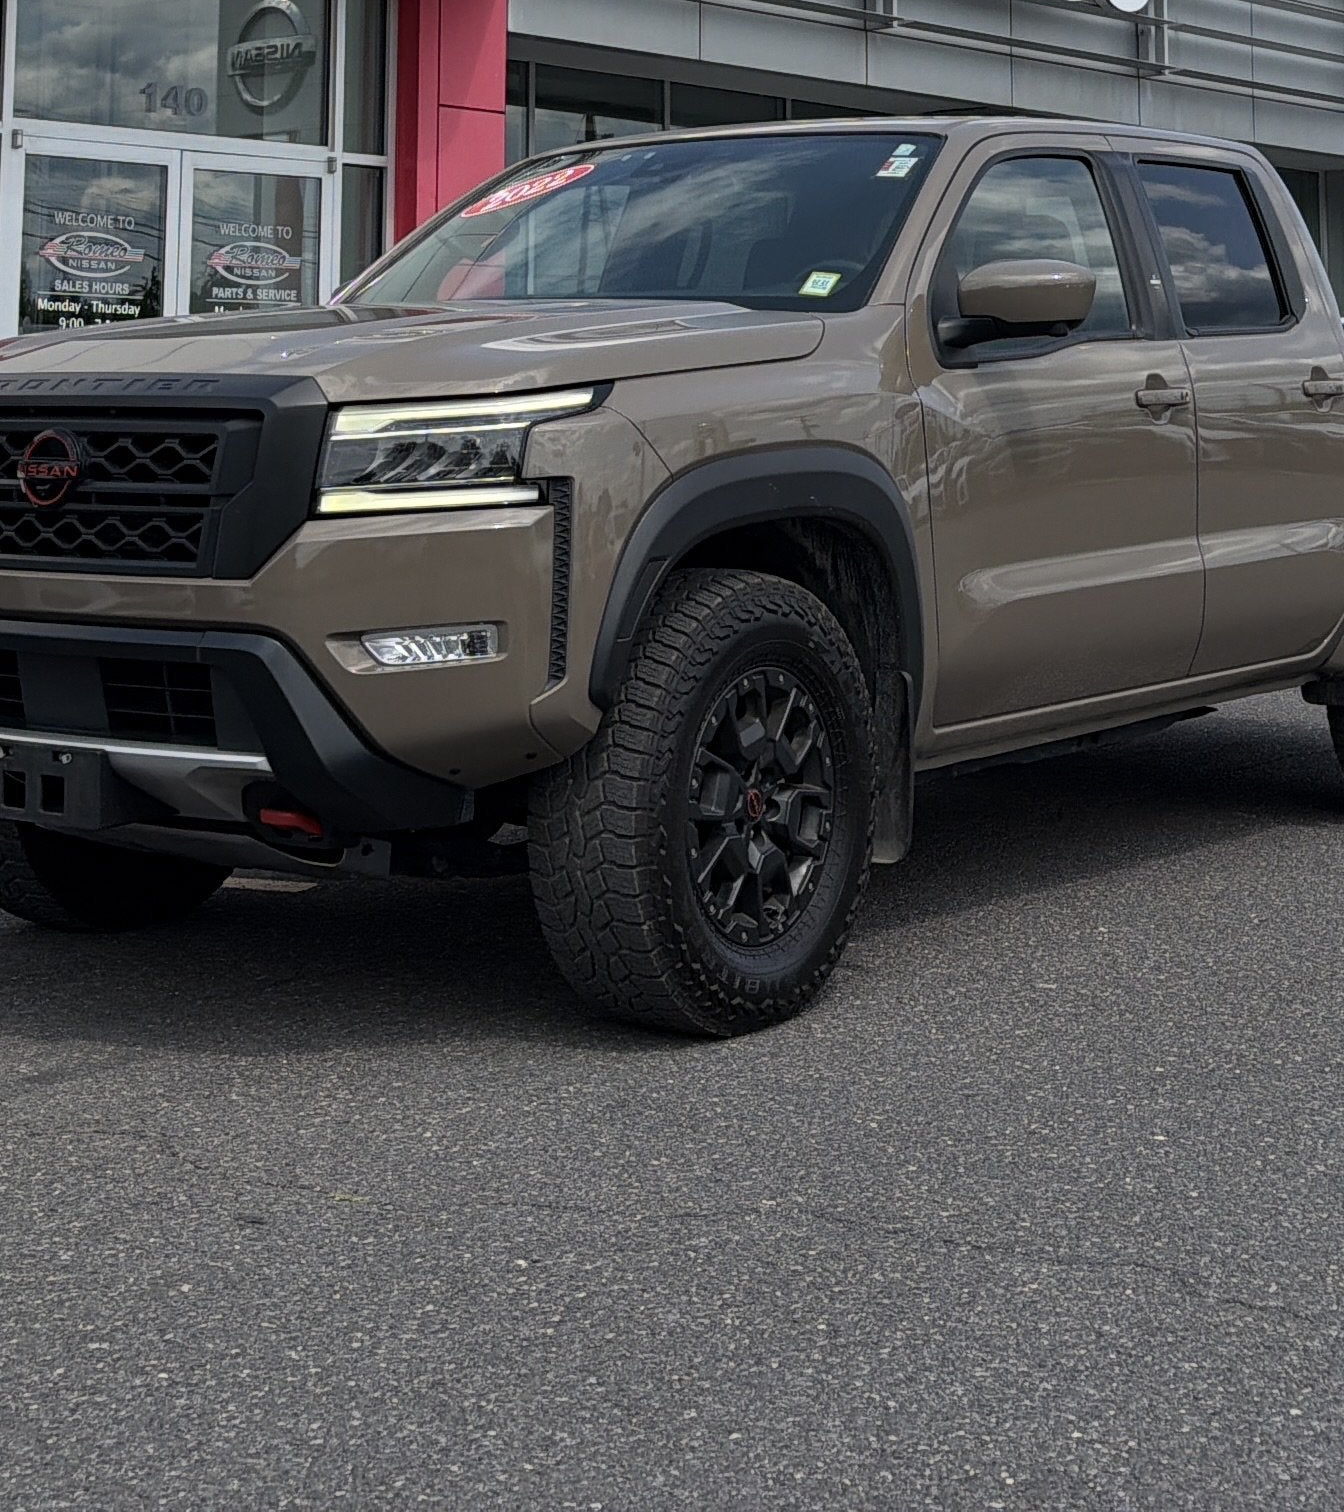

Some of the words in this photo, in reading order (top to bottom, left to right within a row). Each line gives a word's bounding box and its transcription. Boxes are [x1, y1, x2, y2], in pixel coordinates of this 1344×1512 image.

[139, 82, 209, 116] 140
[482, 168, 575, 211] 2022
[55, 211, 114, 228] WELCOME
[118, 216, 135, 229] TO
[219, 223, 274, 238] WELCOME
[276, 226, 292, 239] TO
[59, 235, 128, 258] Romeo
[225, 244, 287, 266] Romeo
[68, 258, 116, 270] NISSAN
[234, 267, 276, 277] NISSAN
[55, 279, 89, 293] SALES
[92, 281, 130, 295] HOURS
[212, 287, 244, 299] PARTS
[246, 288, 254, 299] &
[257, 289, 297, 300] SERVICE
[37, 298, 81, 314] Monday
[91, 301, 141, 317] Thursday
